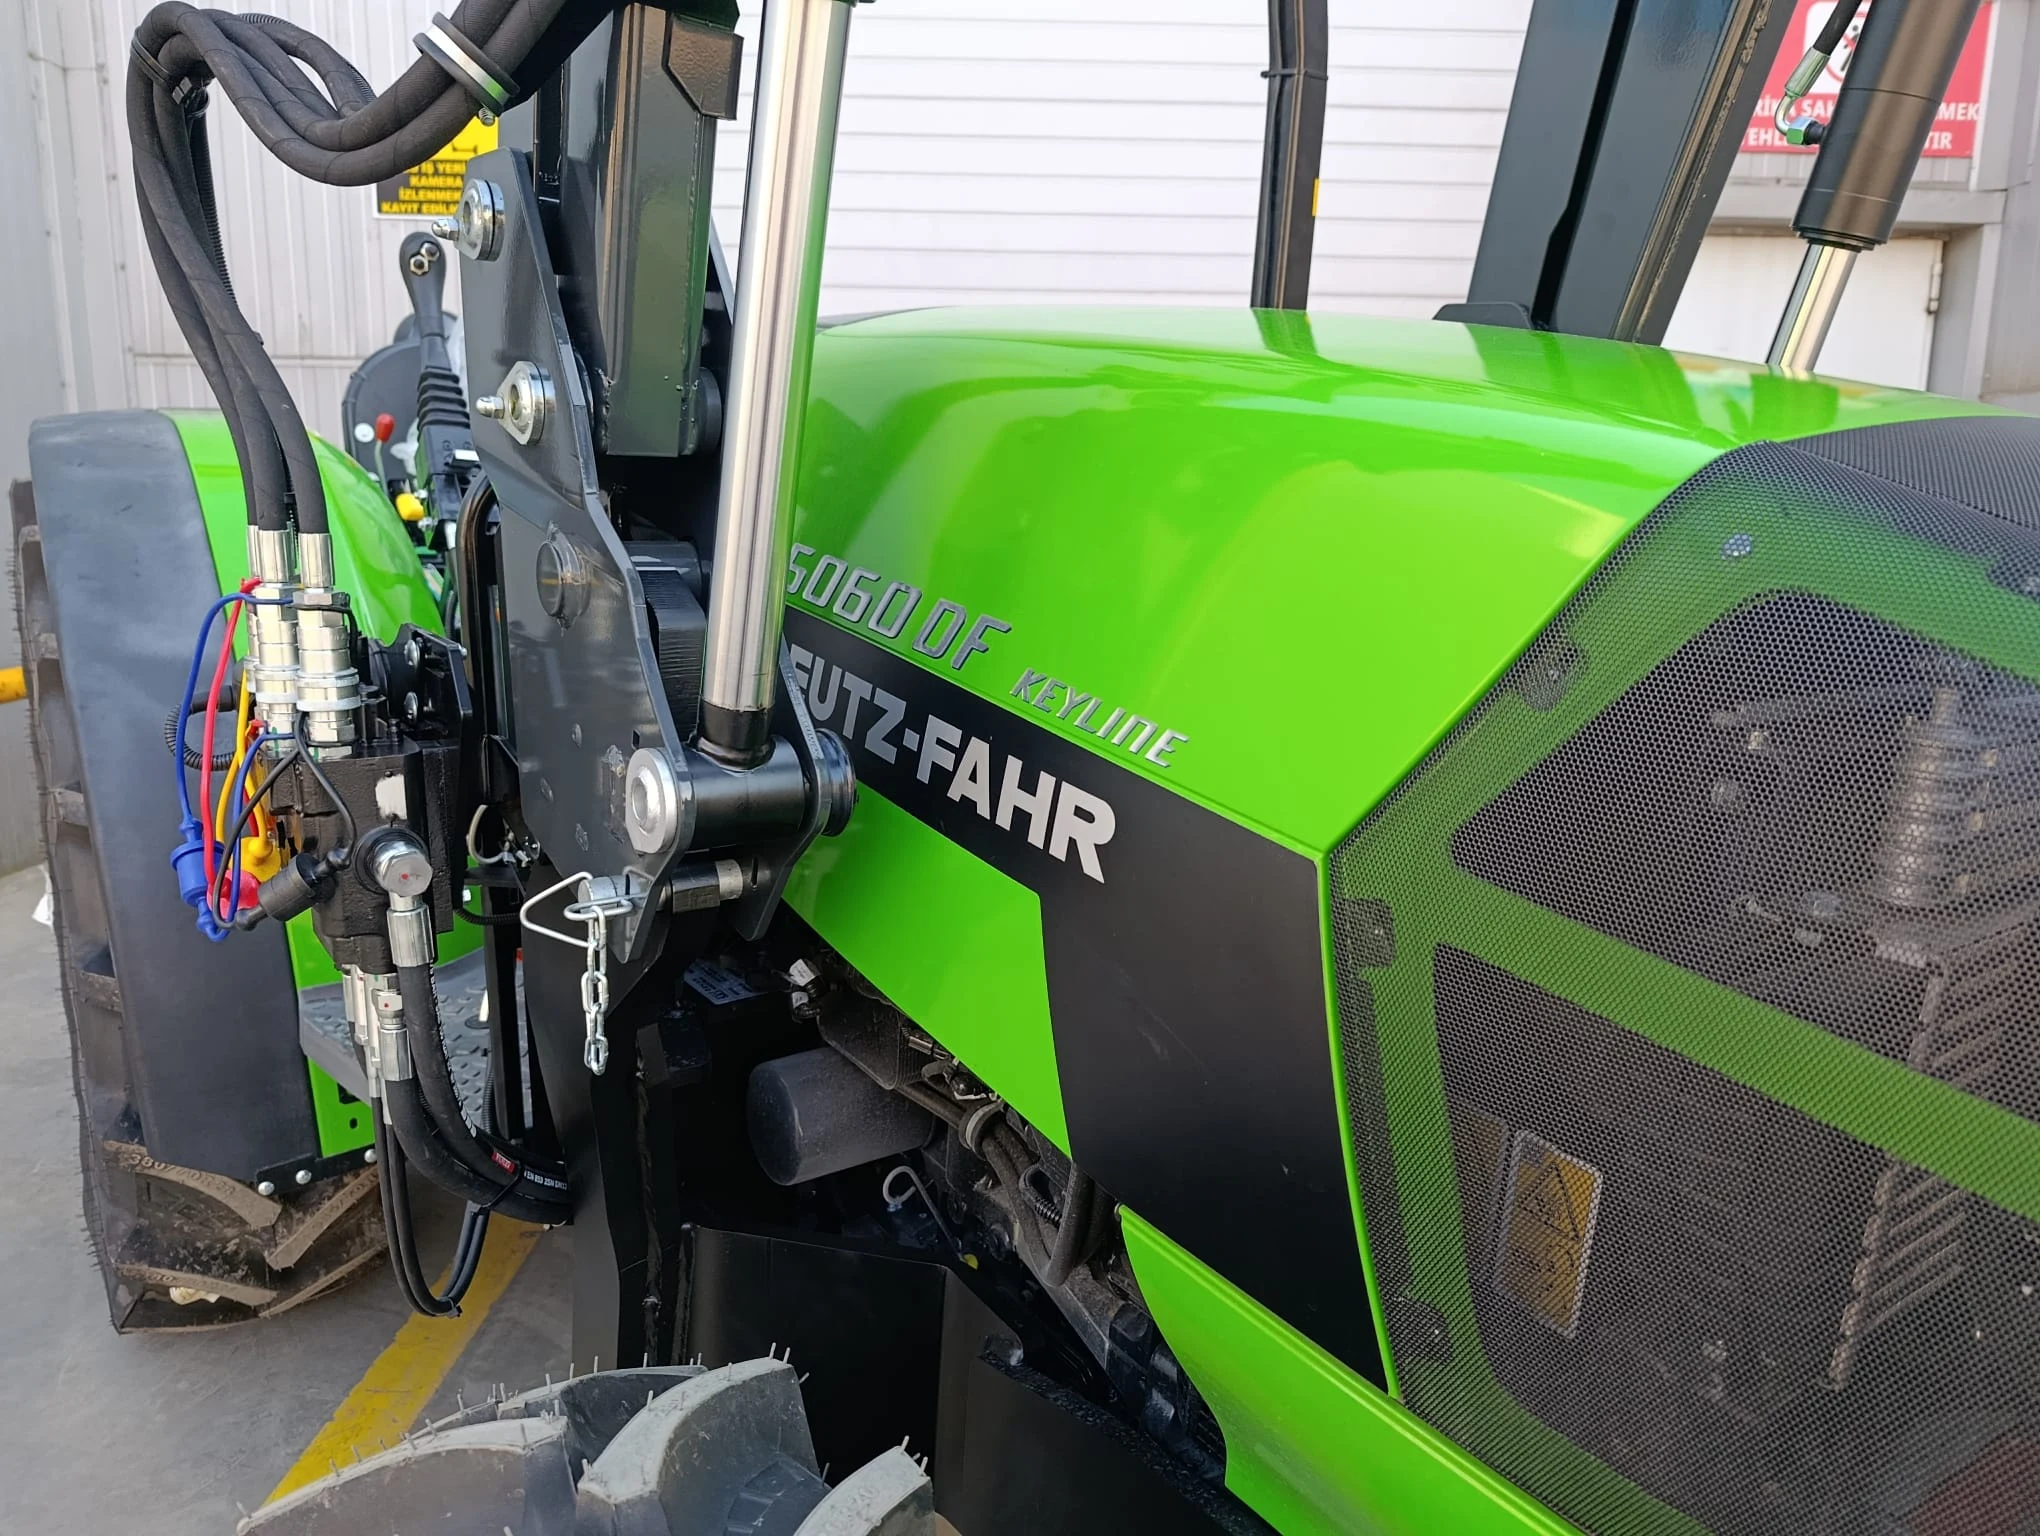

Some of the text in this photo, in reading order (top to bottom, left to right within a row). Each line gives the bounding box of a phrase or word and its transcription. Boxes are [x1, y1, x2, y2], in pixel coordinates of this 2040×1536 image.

[381, 201, 419, 214] KAYIT
[409, 174, 463, 188] KAMERA
[786, 543, 1189, 767] 5060 DF KEYLINE
[790, 644, 1115, 883] EUTZ-FAHR
